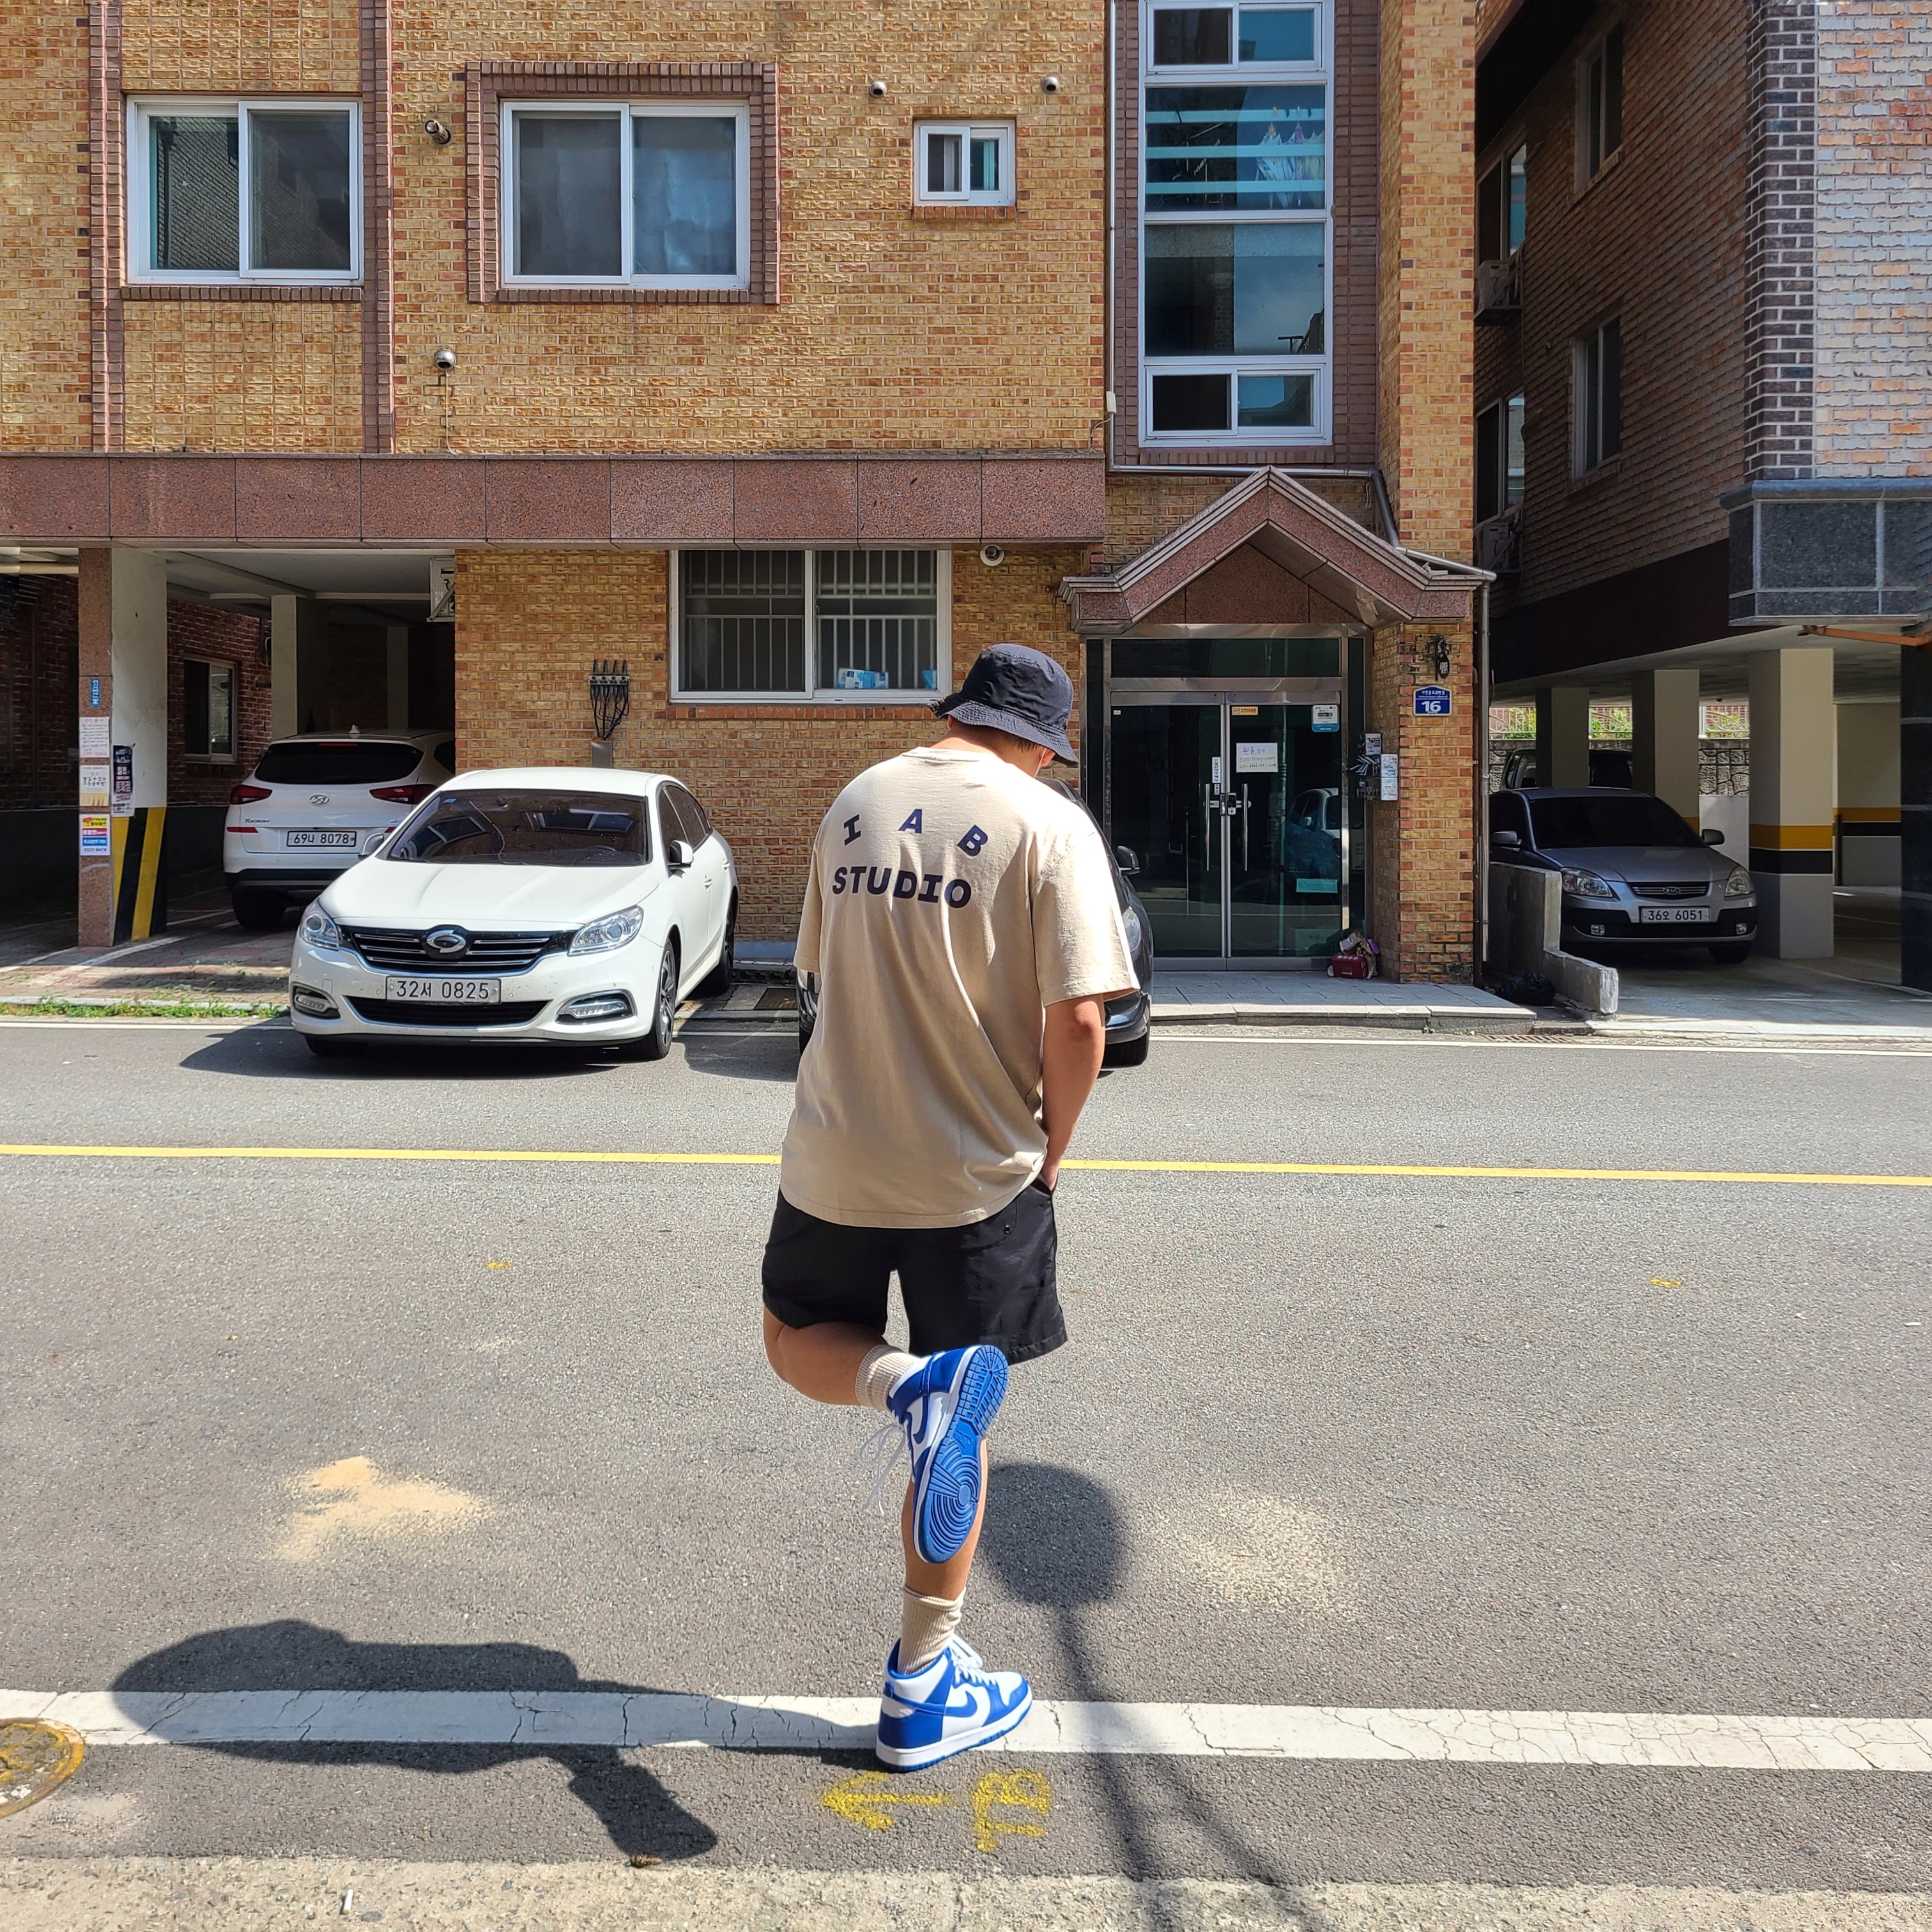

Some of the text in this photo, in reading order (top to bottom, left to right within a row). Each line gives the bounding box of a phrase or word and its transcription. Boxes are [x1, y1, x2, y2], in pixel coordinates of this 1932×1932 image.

[1421, 701, 1441, 712] 16
[320, 834, 349, 844] 8078
[832, 866, 971, 908] STUDIO
[1648, 910, 1702, 921] 36오 6051
[396, 981, 489, 999] 32서 0825
